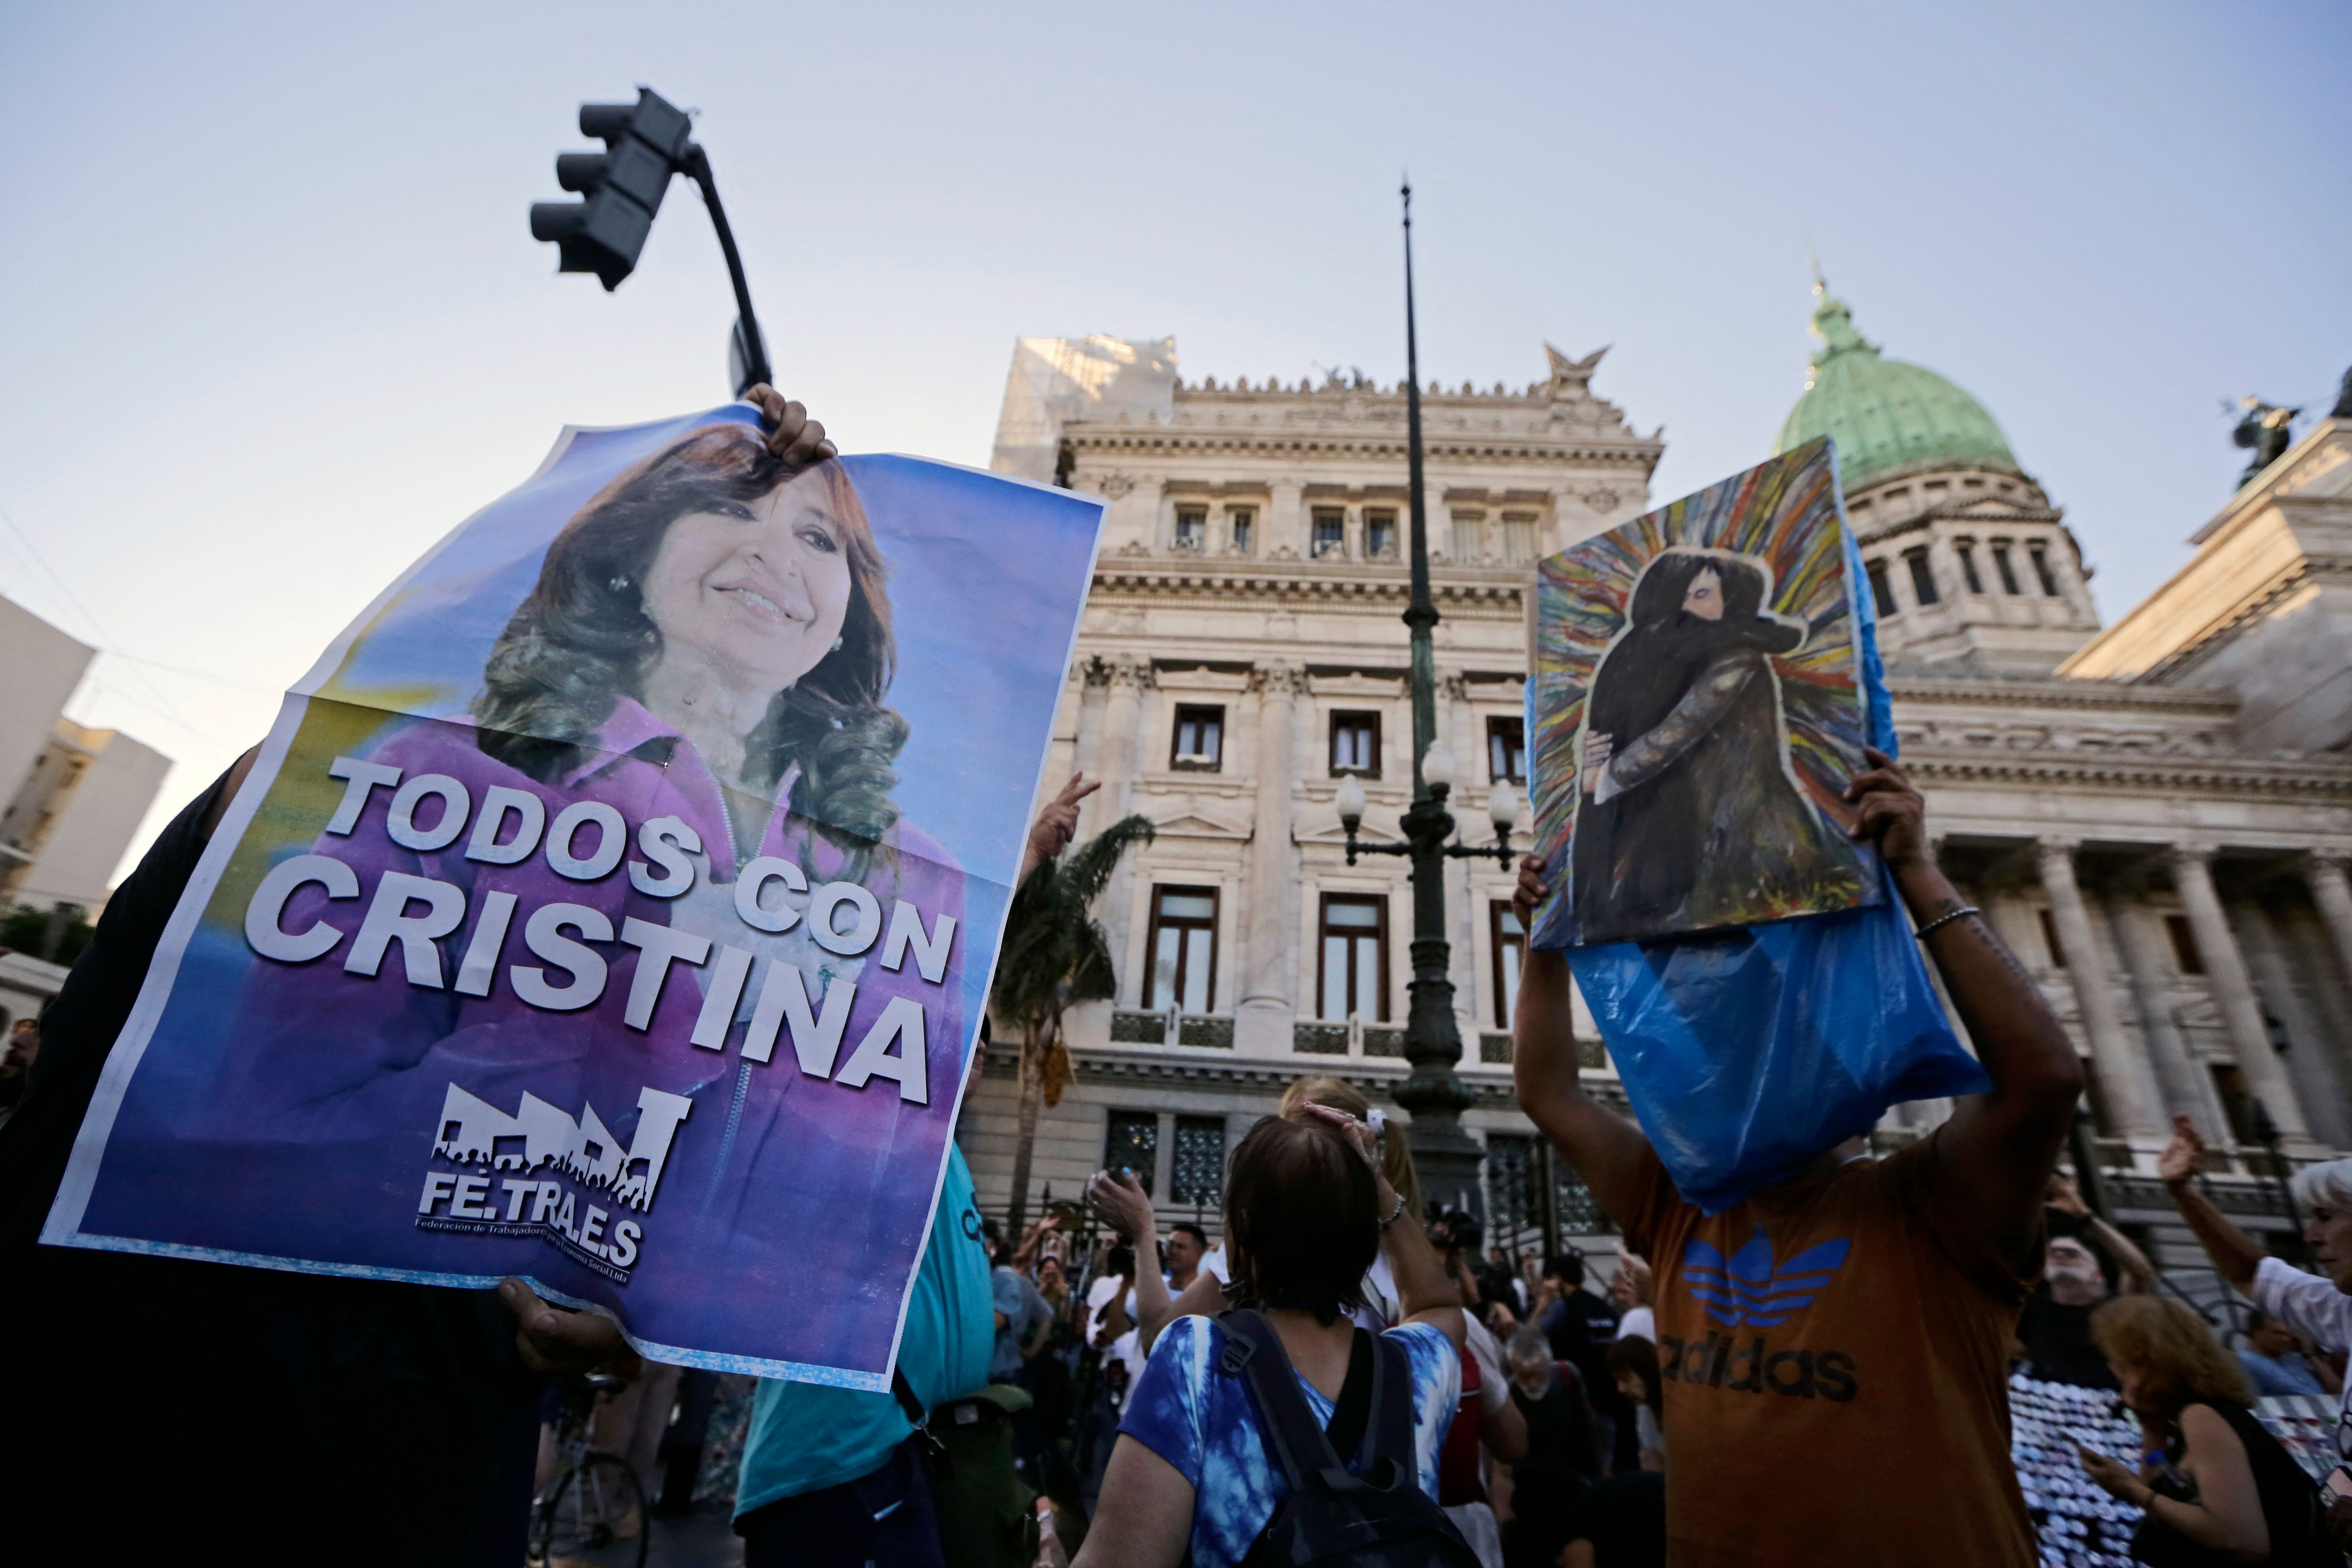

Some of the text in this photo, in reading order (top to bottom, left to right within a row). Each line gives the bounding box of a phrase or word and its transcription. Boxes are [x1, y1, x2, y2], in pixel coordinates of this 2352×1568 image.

[328, 757, 956, 983] TODOS CON
[245, 854, 928, 1105] CRISTINA
[415, 1218, 470, 1232] Federación
[473, 1224, 485, 1233] de
[489, 1225, 547, 1236] Trabajadores
[1658, 1330, 1858, 1402] adidas
